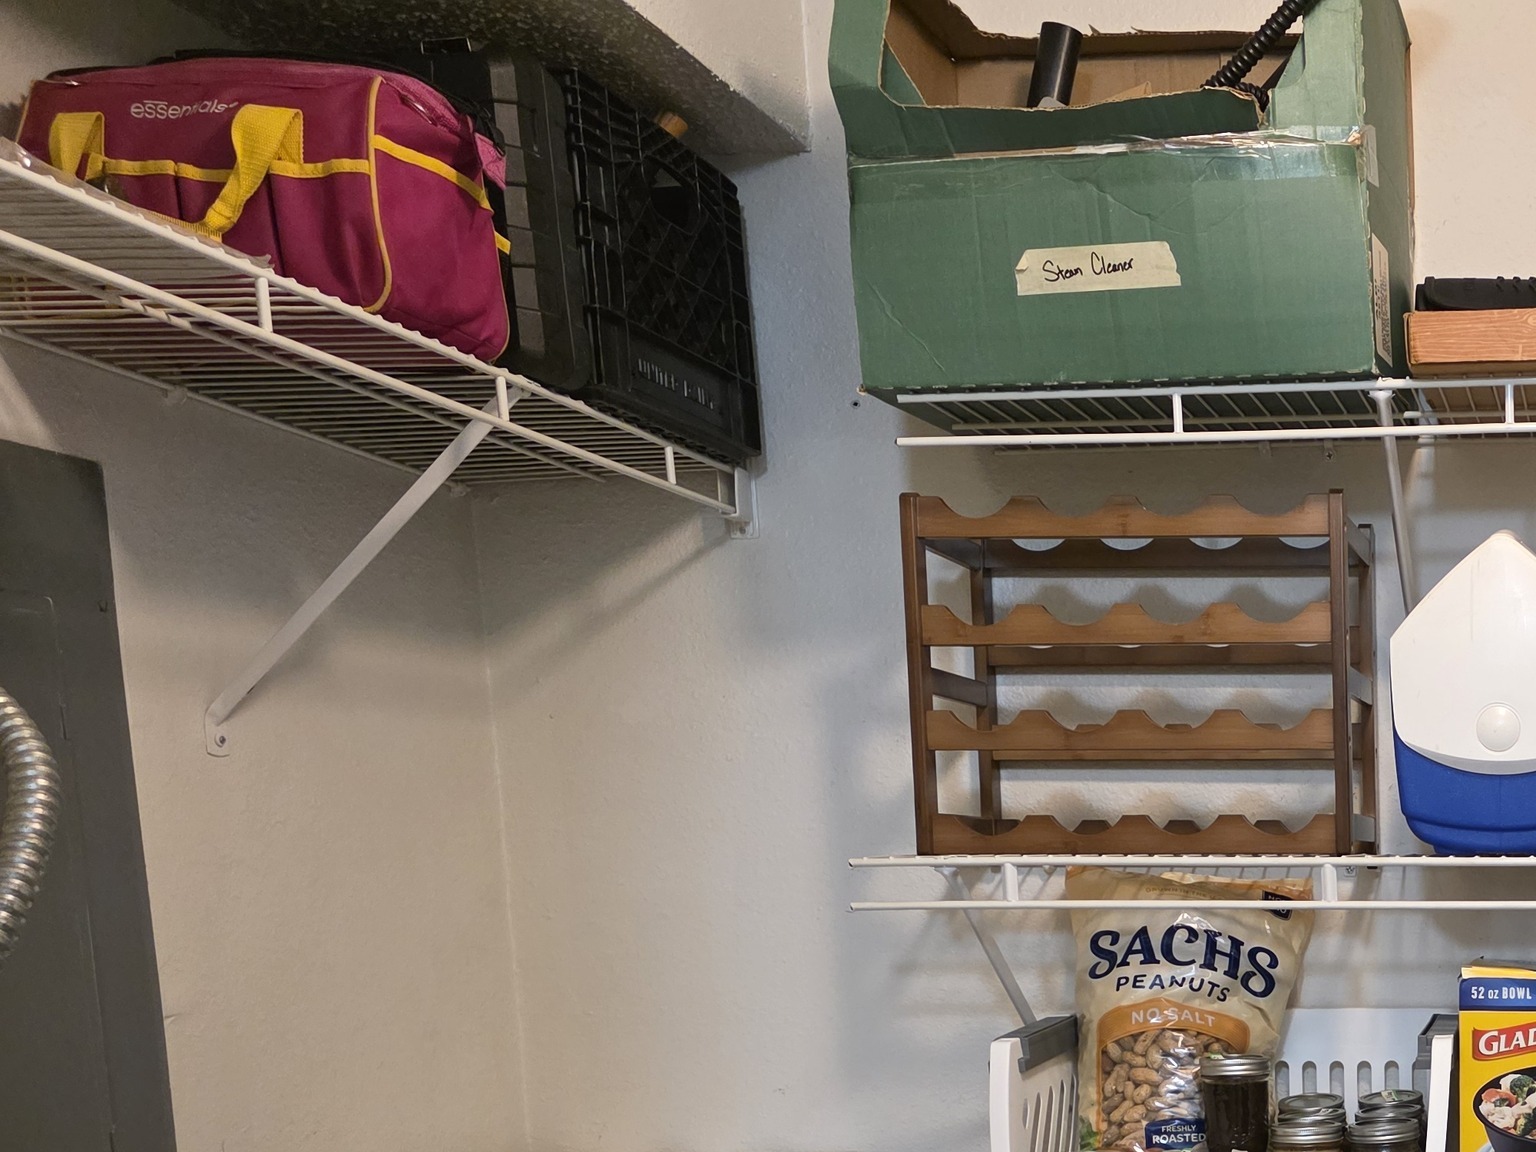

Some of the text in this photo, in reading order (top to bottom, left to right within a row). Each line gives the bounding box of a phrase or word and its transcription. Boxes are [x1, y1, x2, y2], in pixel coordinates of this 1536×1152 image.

[130, 100, 228, 119] essentials
[1042, 252, 1134, 283] Steam Cleaner
[1088, 923, 1279, 998] SACHS
[1115, 974, 1231, 1002] PEANUTS
[1471, 987, 1532, 999] 52 oz BOWL
[1131, 1007, 1216, 1027] NO SALT
[1152, 1132, 1207, 1144] ROASTED
[1161, 1124, 1197, 1133] FRESHLY
